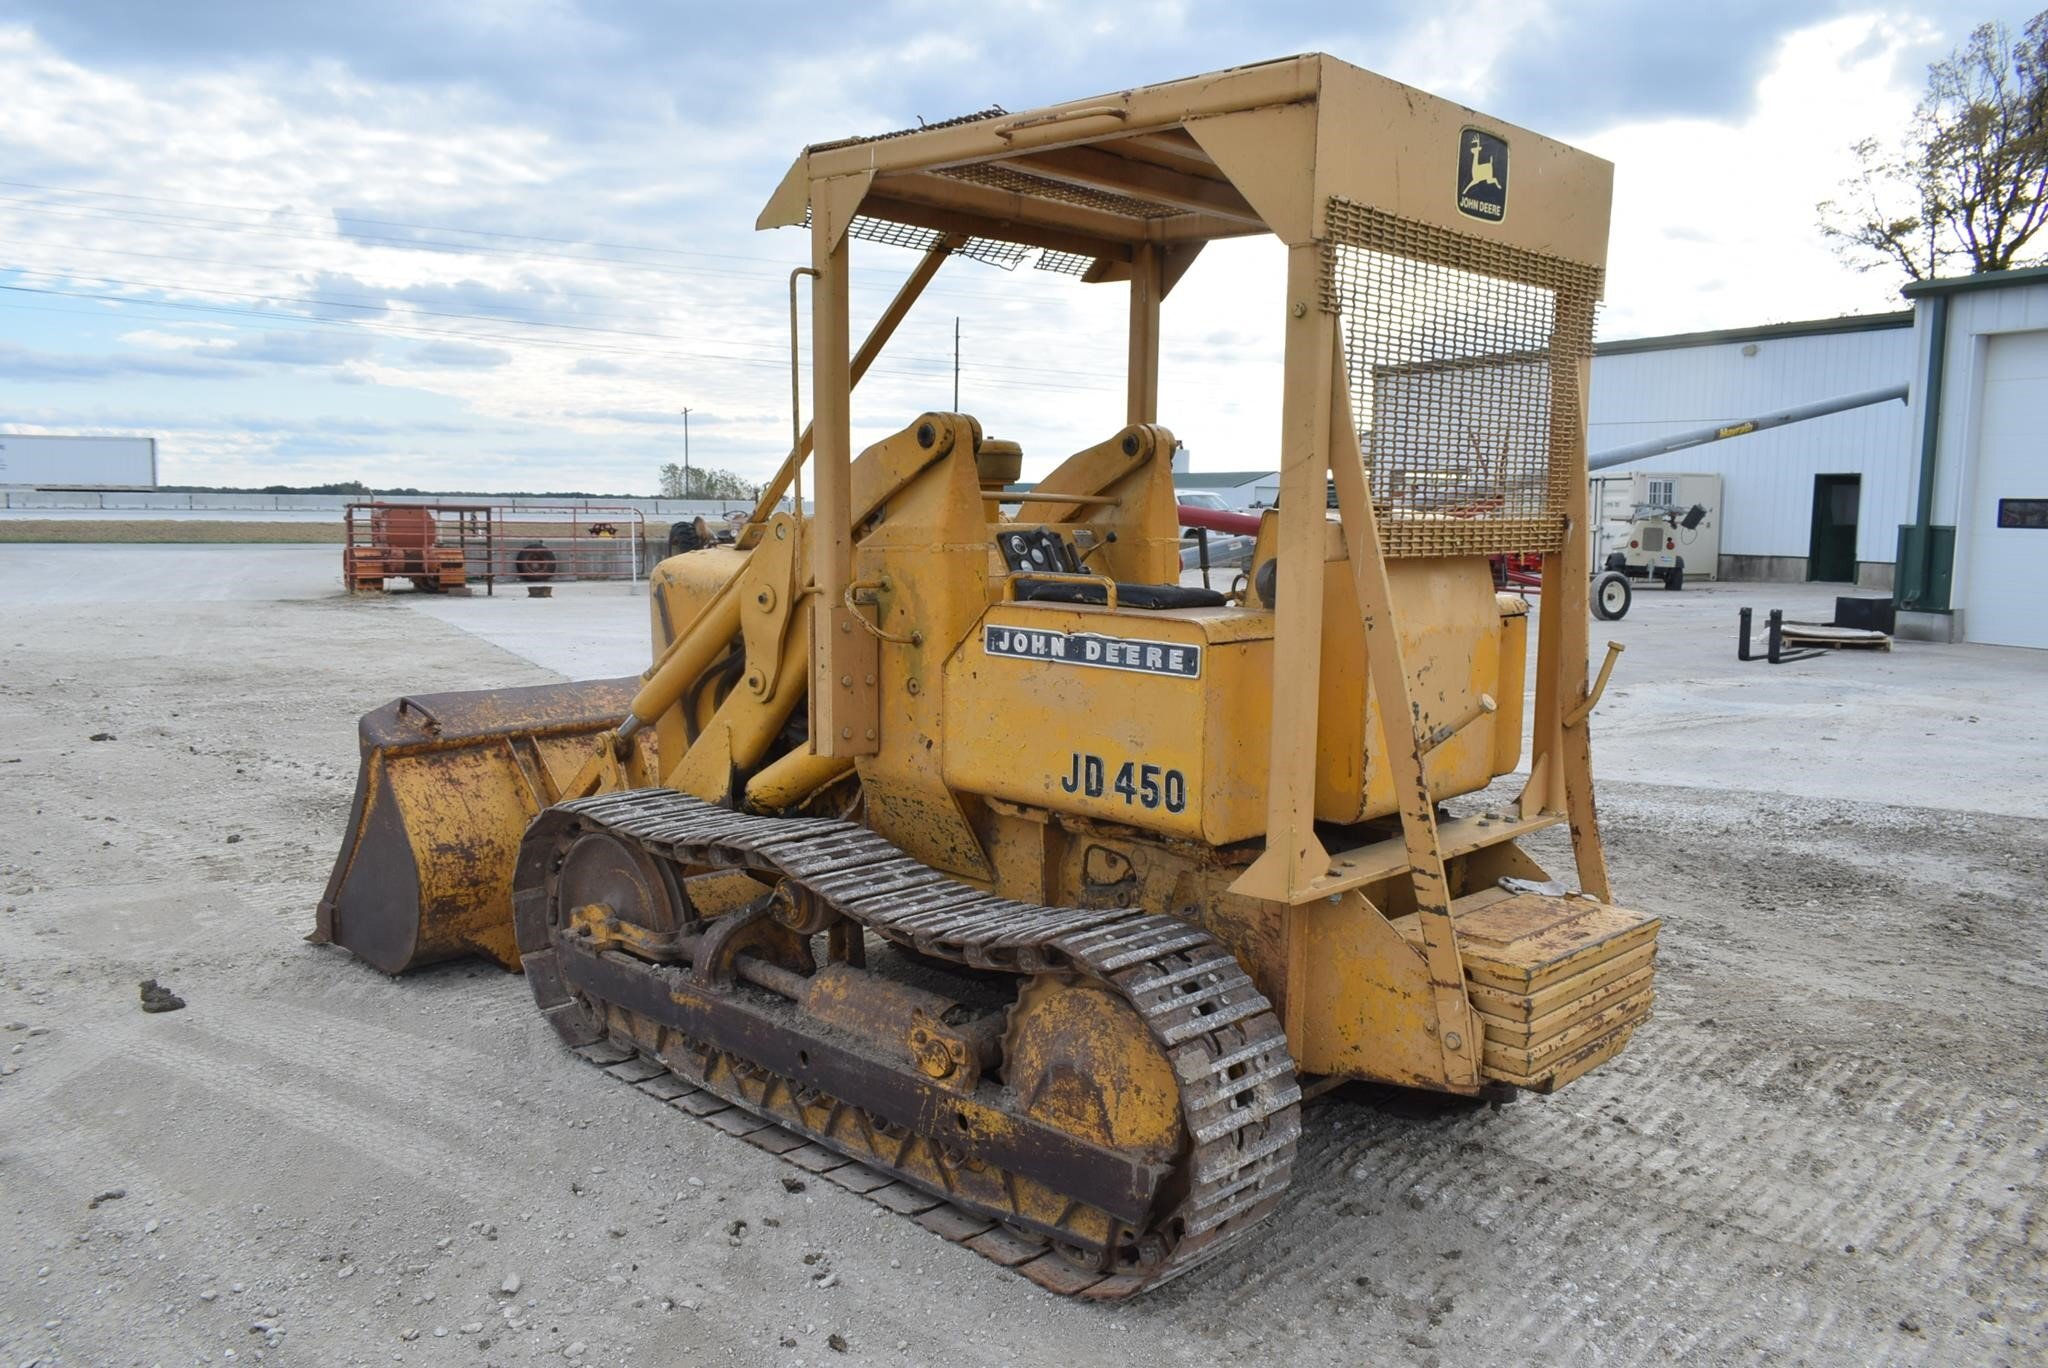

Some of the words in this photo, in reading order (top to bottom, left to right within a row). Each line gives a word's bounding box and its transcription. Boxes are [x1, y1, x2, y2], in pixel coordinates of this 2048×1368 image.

[1460, 196, 1478, 210] JOHN
[1480, 201, 1501, 216] DEERE
[999, 631, 1065, 657] JOHN
[1085, 640, 1184, 670] DEERE
[1061, 752, 1104, 798] JD
[1114, 762, 1186, 814] 450
